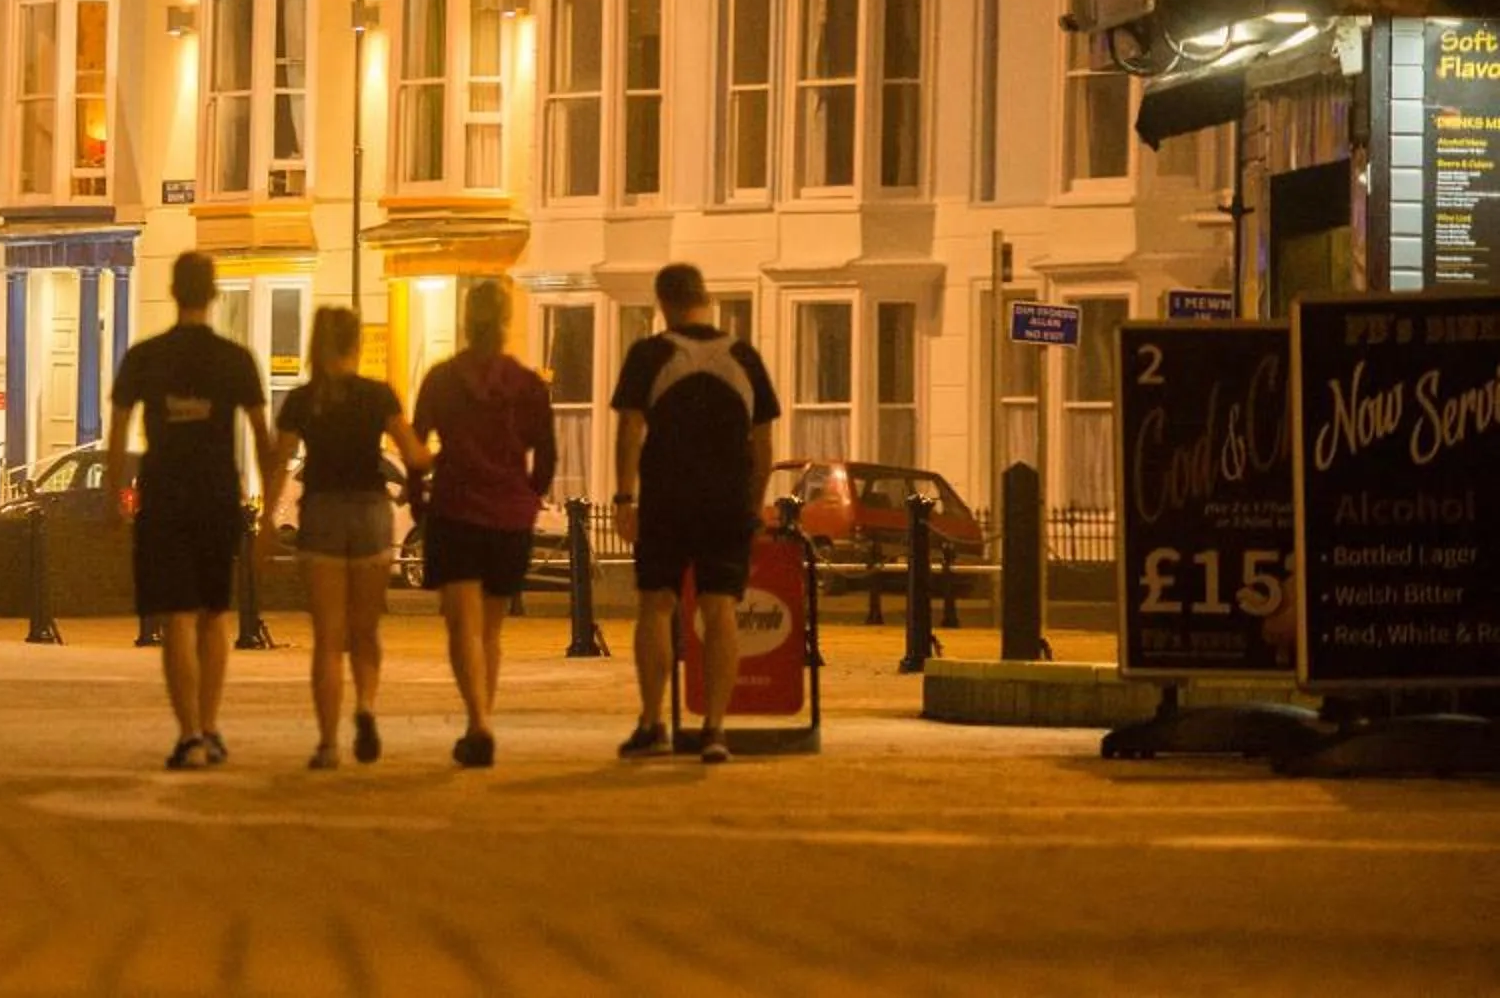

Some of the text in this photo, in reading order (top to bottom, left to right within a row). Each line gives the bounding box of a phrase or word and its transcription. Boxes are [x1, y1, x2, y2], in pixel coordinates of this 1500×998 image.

[1440, 28, 1499, 53] Soft
[1136, 343, 1167, 385] 2
[1315, 360, 1404, 471] Now
[1334, 490, 1477, 525] Alcohol
[1333, 544, 1478, 569] Bottled Lager
[1138, 547, 1295, 616] £15
[1335, 584, 1465, 606] Welsh Bitter
[1333, 623, 1384, 649] Red,
[1386, 623, 1450, 645] White
